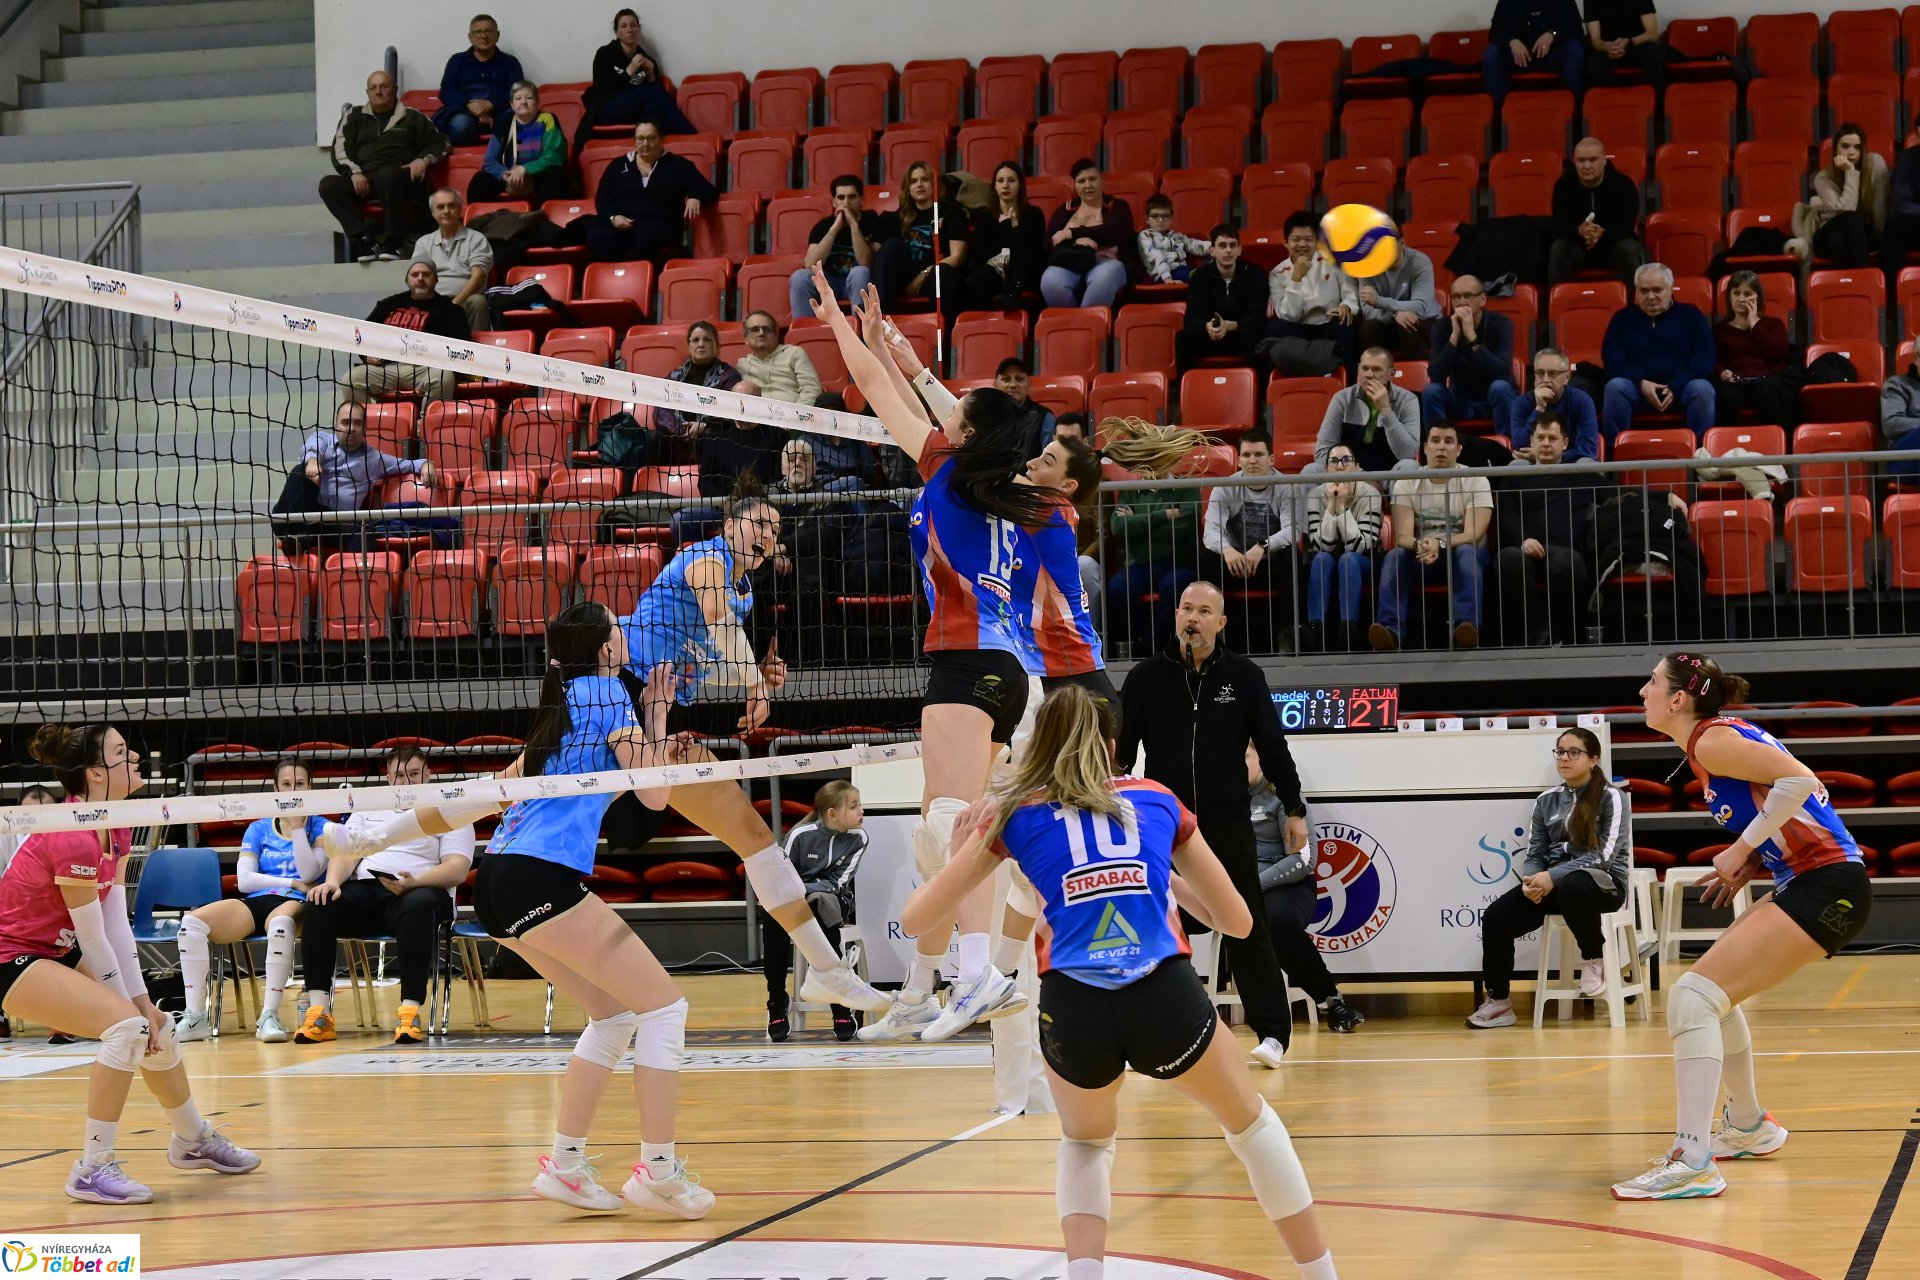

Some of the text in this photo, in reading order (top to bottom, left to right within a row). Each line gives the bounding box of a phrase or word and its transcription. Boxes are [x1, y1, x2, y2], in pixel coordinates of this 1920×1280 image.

[1352, 688, 1397, 699] FATUM
[1281, 701, 1301, 728] 6
[1350, 700, 1390, 727] 21
[1054, 798, 1141, 867] 10
